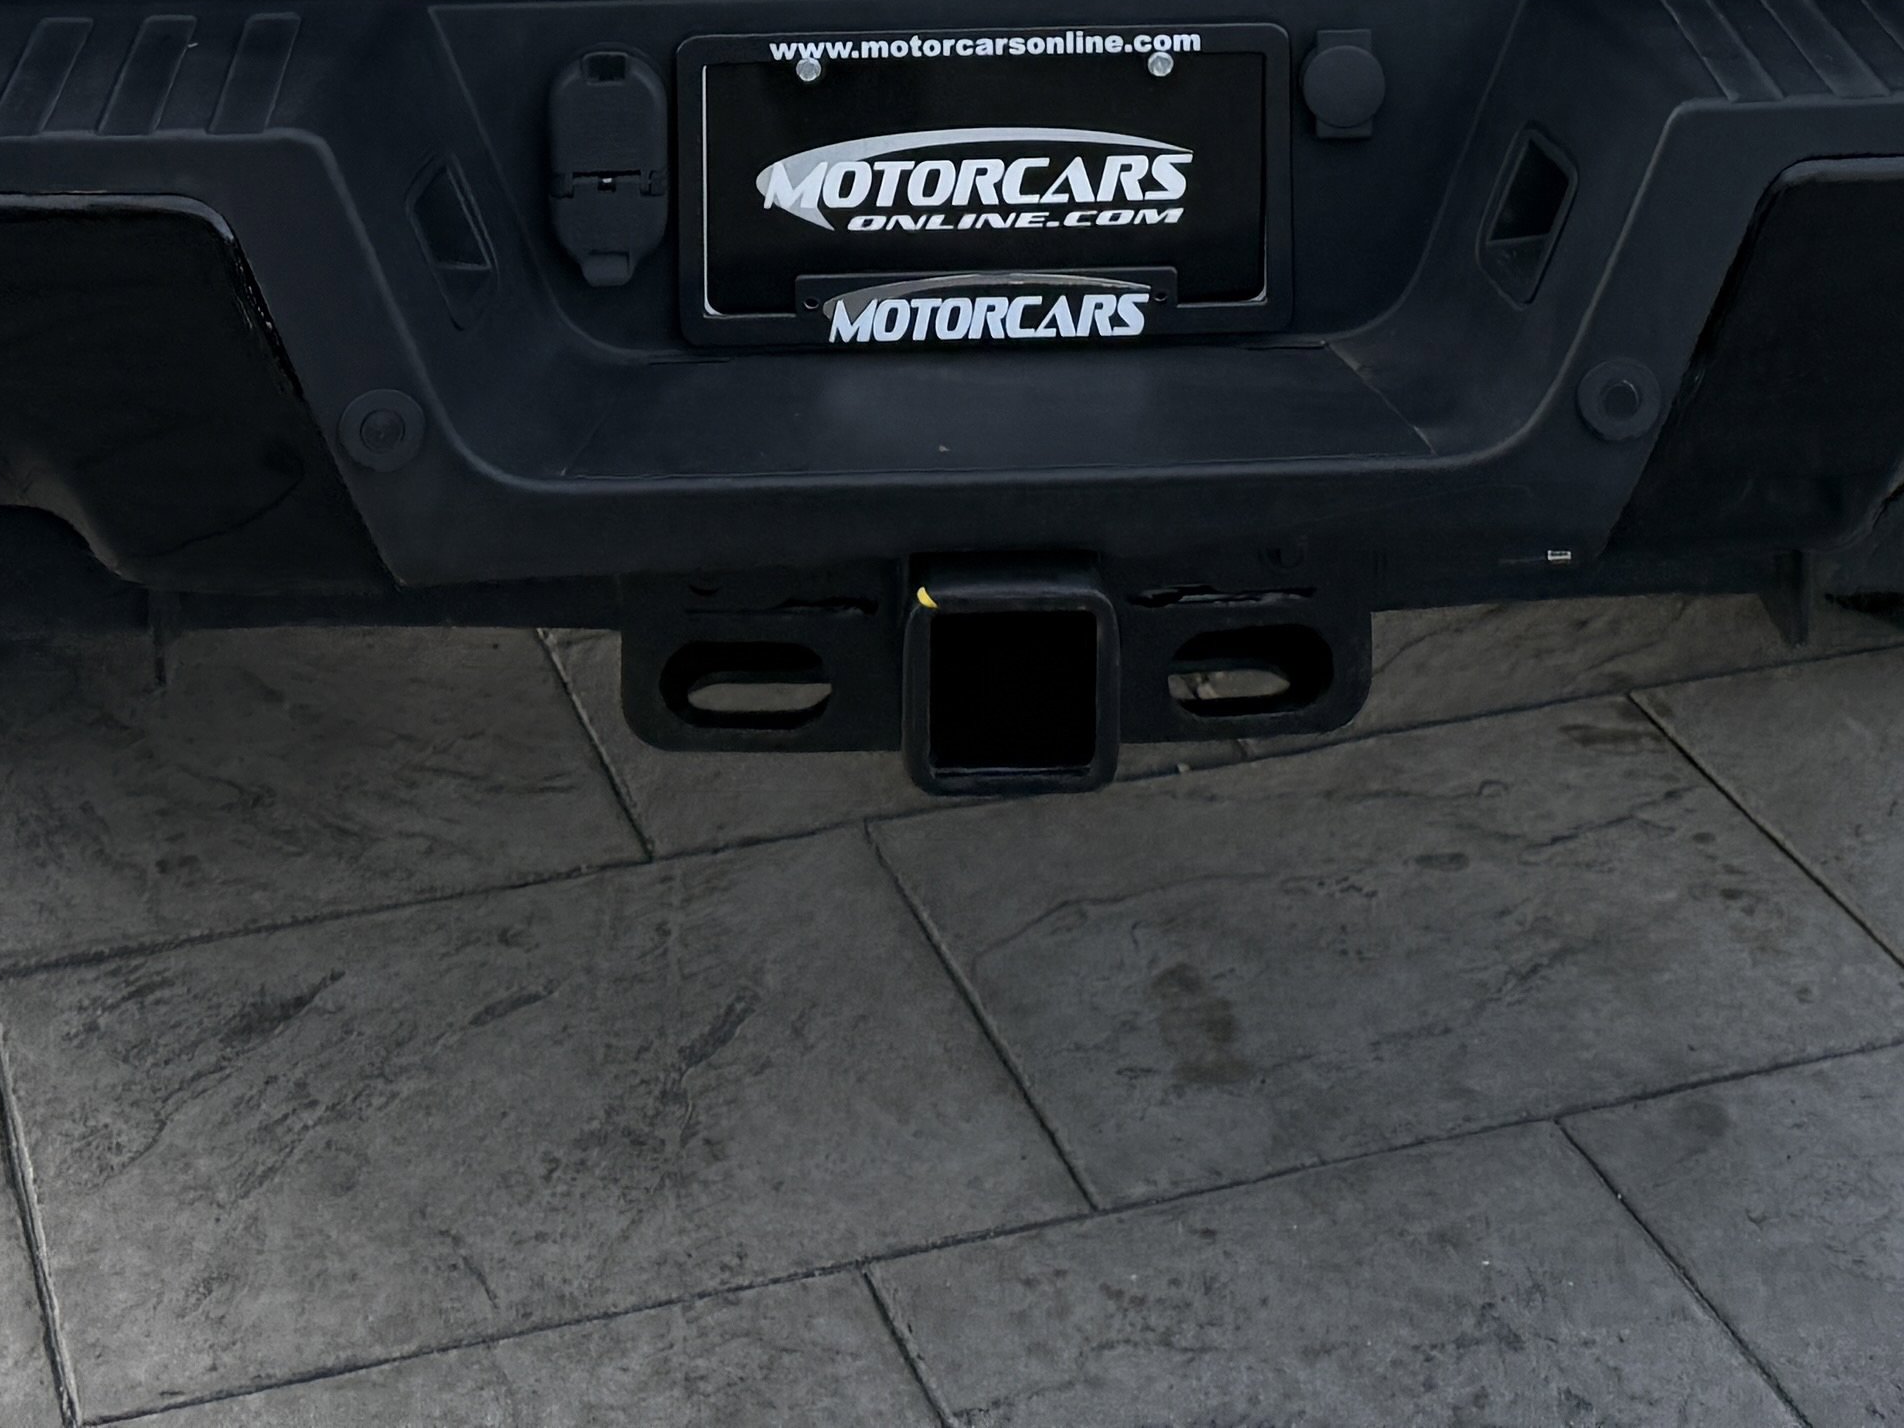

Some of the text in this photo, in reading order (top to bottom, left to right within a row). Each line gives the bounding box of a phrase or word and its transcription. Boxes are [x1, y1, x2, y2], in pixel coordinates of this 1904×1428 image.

[769, 31, 1201, 61] www.motorcarsonline.com
[763, 153, 1194, 209] MOTORCARS
[848, 207, 1184, 231] ONLINE.COM
[828, 293, 1150, 343] MOTORCARS
